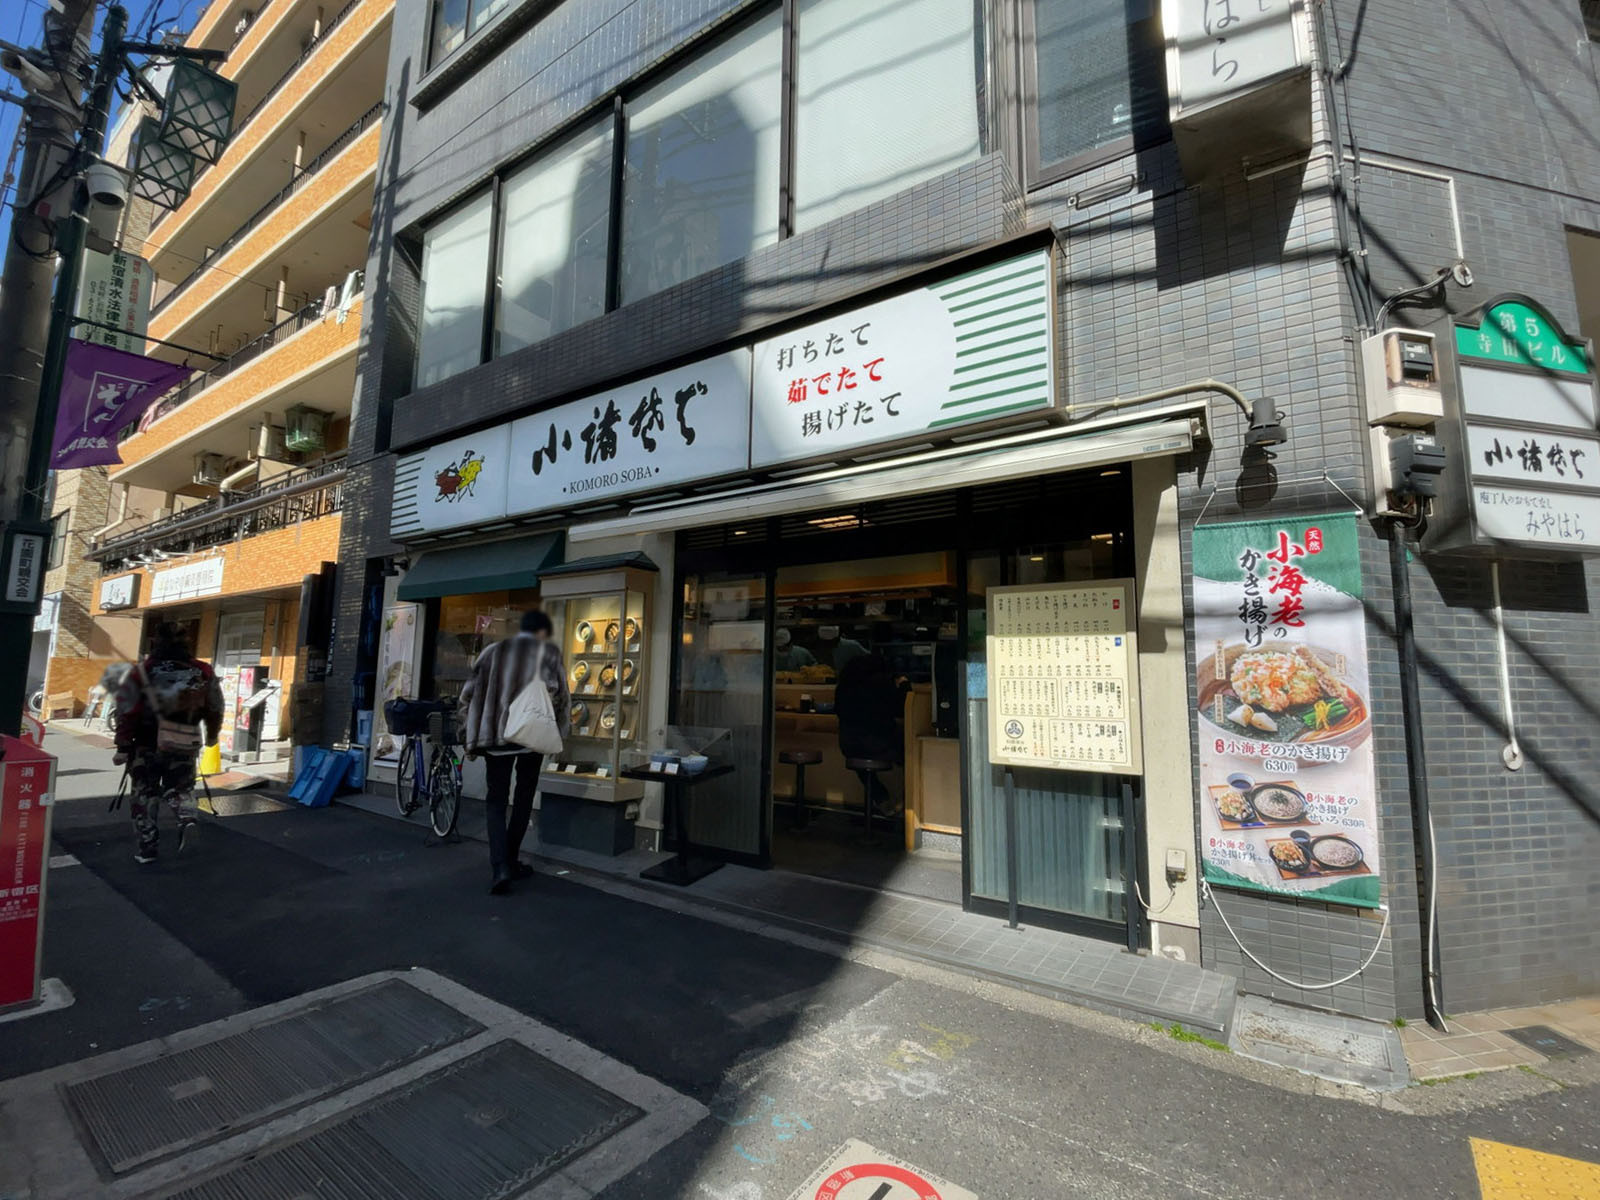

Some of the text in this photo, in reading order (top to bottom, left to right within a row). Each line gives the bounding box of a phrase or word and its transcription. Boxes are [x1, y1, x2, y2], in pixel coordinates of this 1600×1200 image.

[777, 322, 872, 371] 打ちたて
[787, 357, 885, 406] 茹でたて
[801, 391, 903, 438] 揚げたて
[569, 466, 653, 494] KOMORO SOBA
[1526, 511, 1585, 541] みやはら
[1308, 529, 1321, 551] 天然
[1267, 532, 1309, 638] 小海老の
[1238, 549, 1268, 648] かき揚げ
[1227, 740, 1348, 761] 小海老のかき揚げ
[1265, 759, 1296, 772] 630円
[1307, 804, 1350, 816] かき揚げ
[1314, 794, 1358, 806] 小海老の
[1309, 814, 1340, 825] せいろ
[1217, 839, 1255, 851] 小海老の
